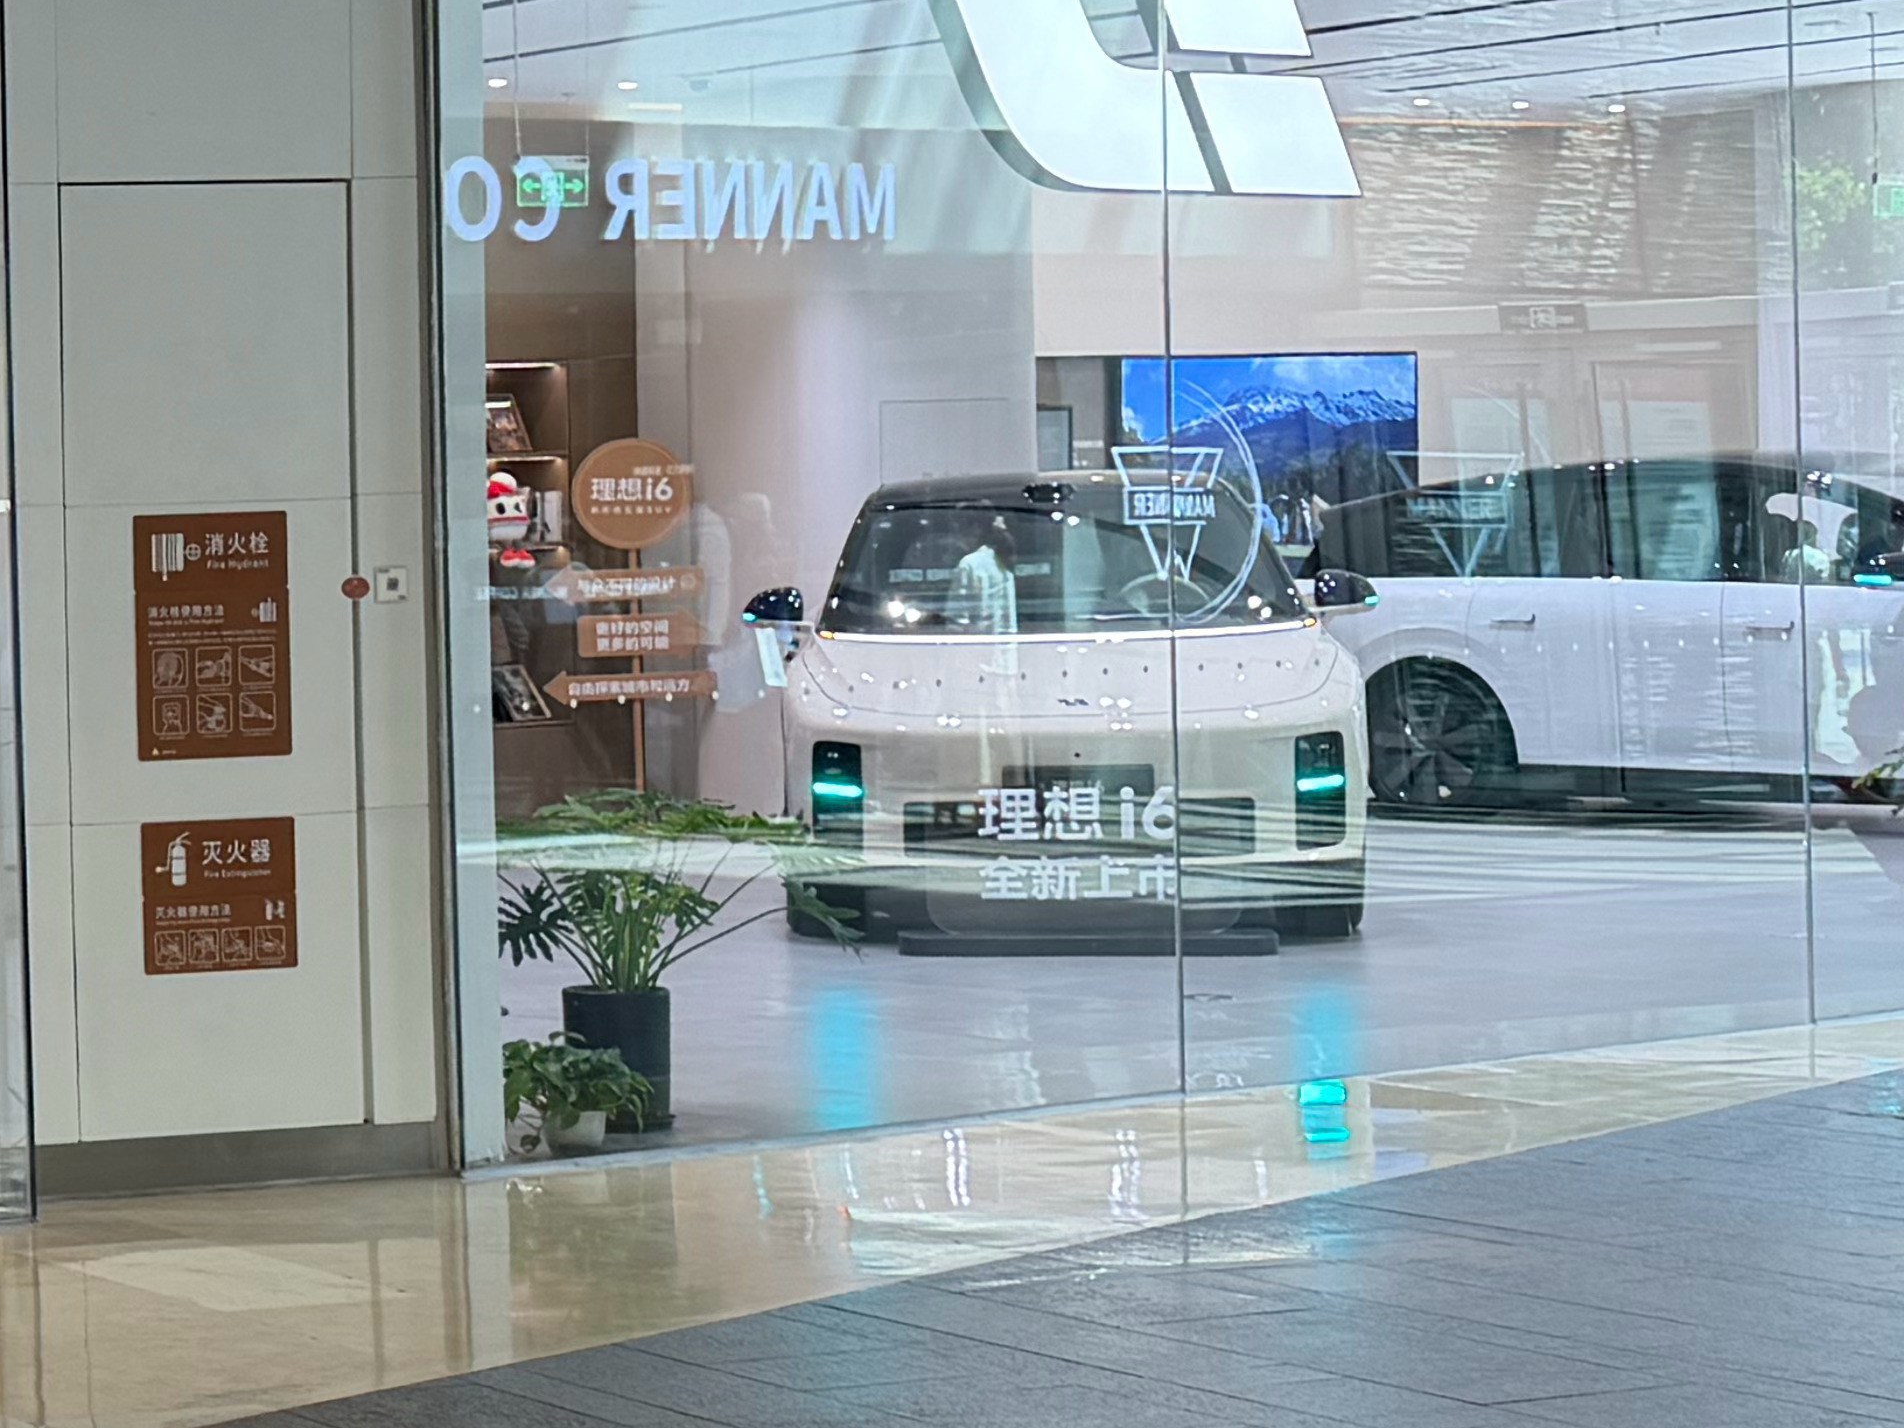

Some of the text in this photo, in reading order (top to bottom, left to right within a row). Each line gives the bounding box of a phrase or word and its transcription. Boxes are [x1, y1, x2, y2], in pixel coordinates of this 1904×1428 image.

[204, 531, 270, 556] 消火栓
[976, 785, 1176, 841] 理想 i6
[201, 838, 272, 866] 灭火器
[978, 854, 1177, 901] 全新上市
